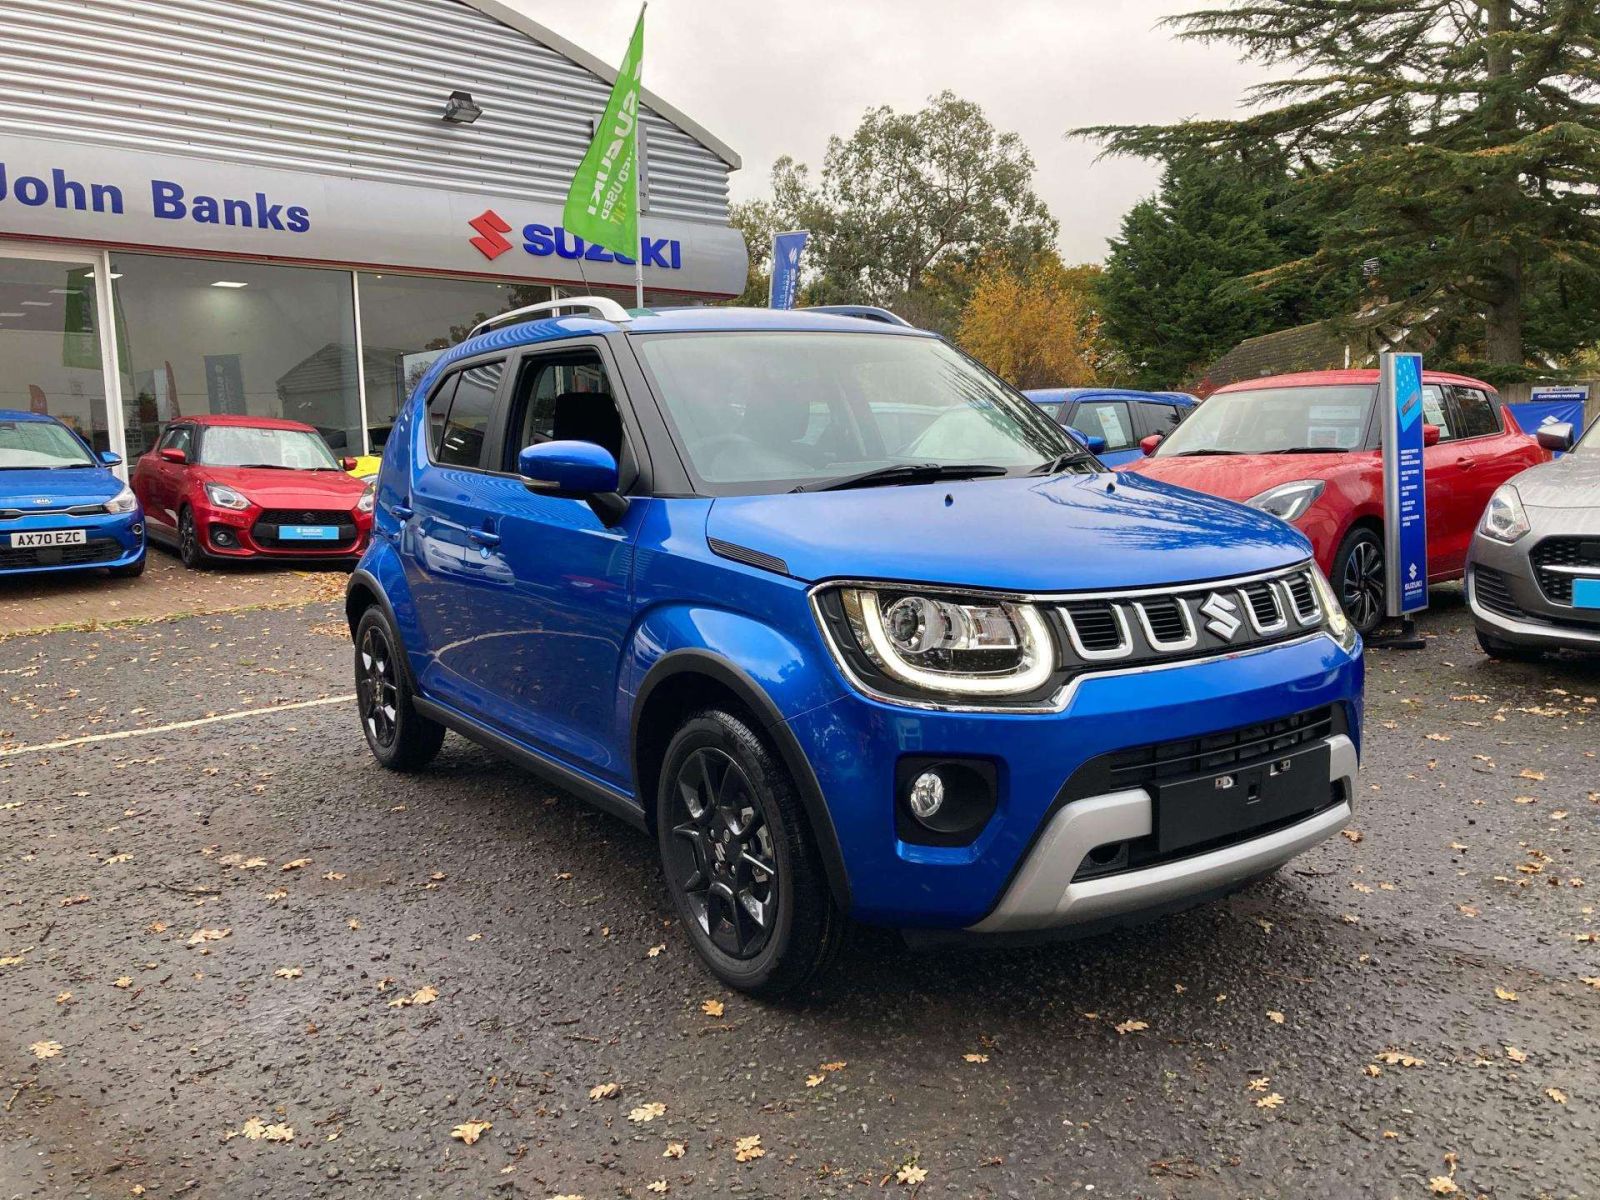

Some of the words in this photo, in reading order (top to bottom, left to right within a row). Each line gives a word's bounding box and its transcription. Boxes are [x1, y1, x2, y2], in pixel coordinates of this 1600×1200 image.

[151, 179, 311, 233] Banks
[522, 223, 681, 269] SUKI
[18, 534, 52, 546] AX70
[55, 532, 81, 543] EZC
